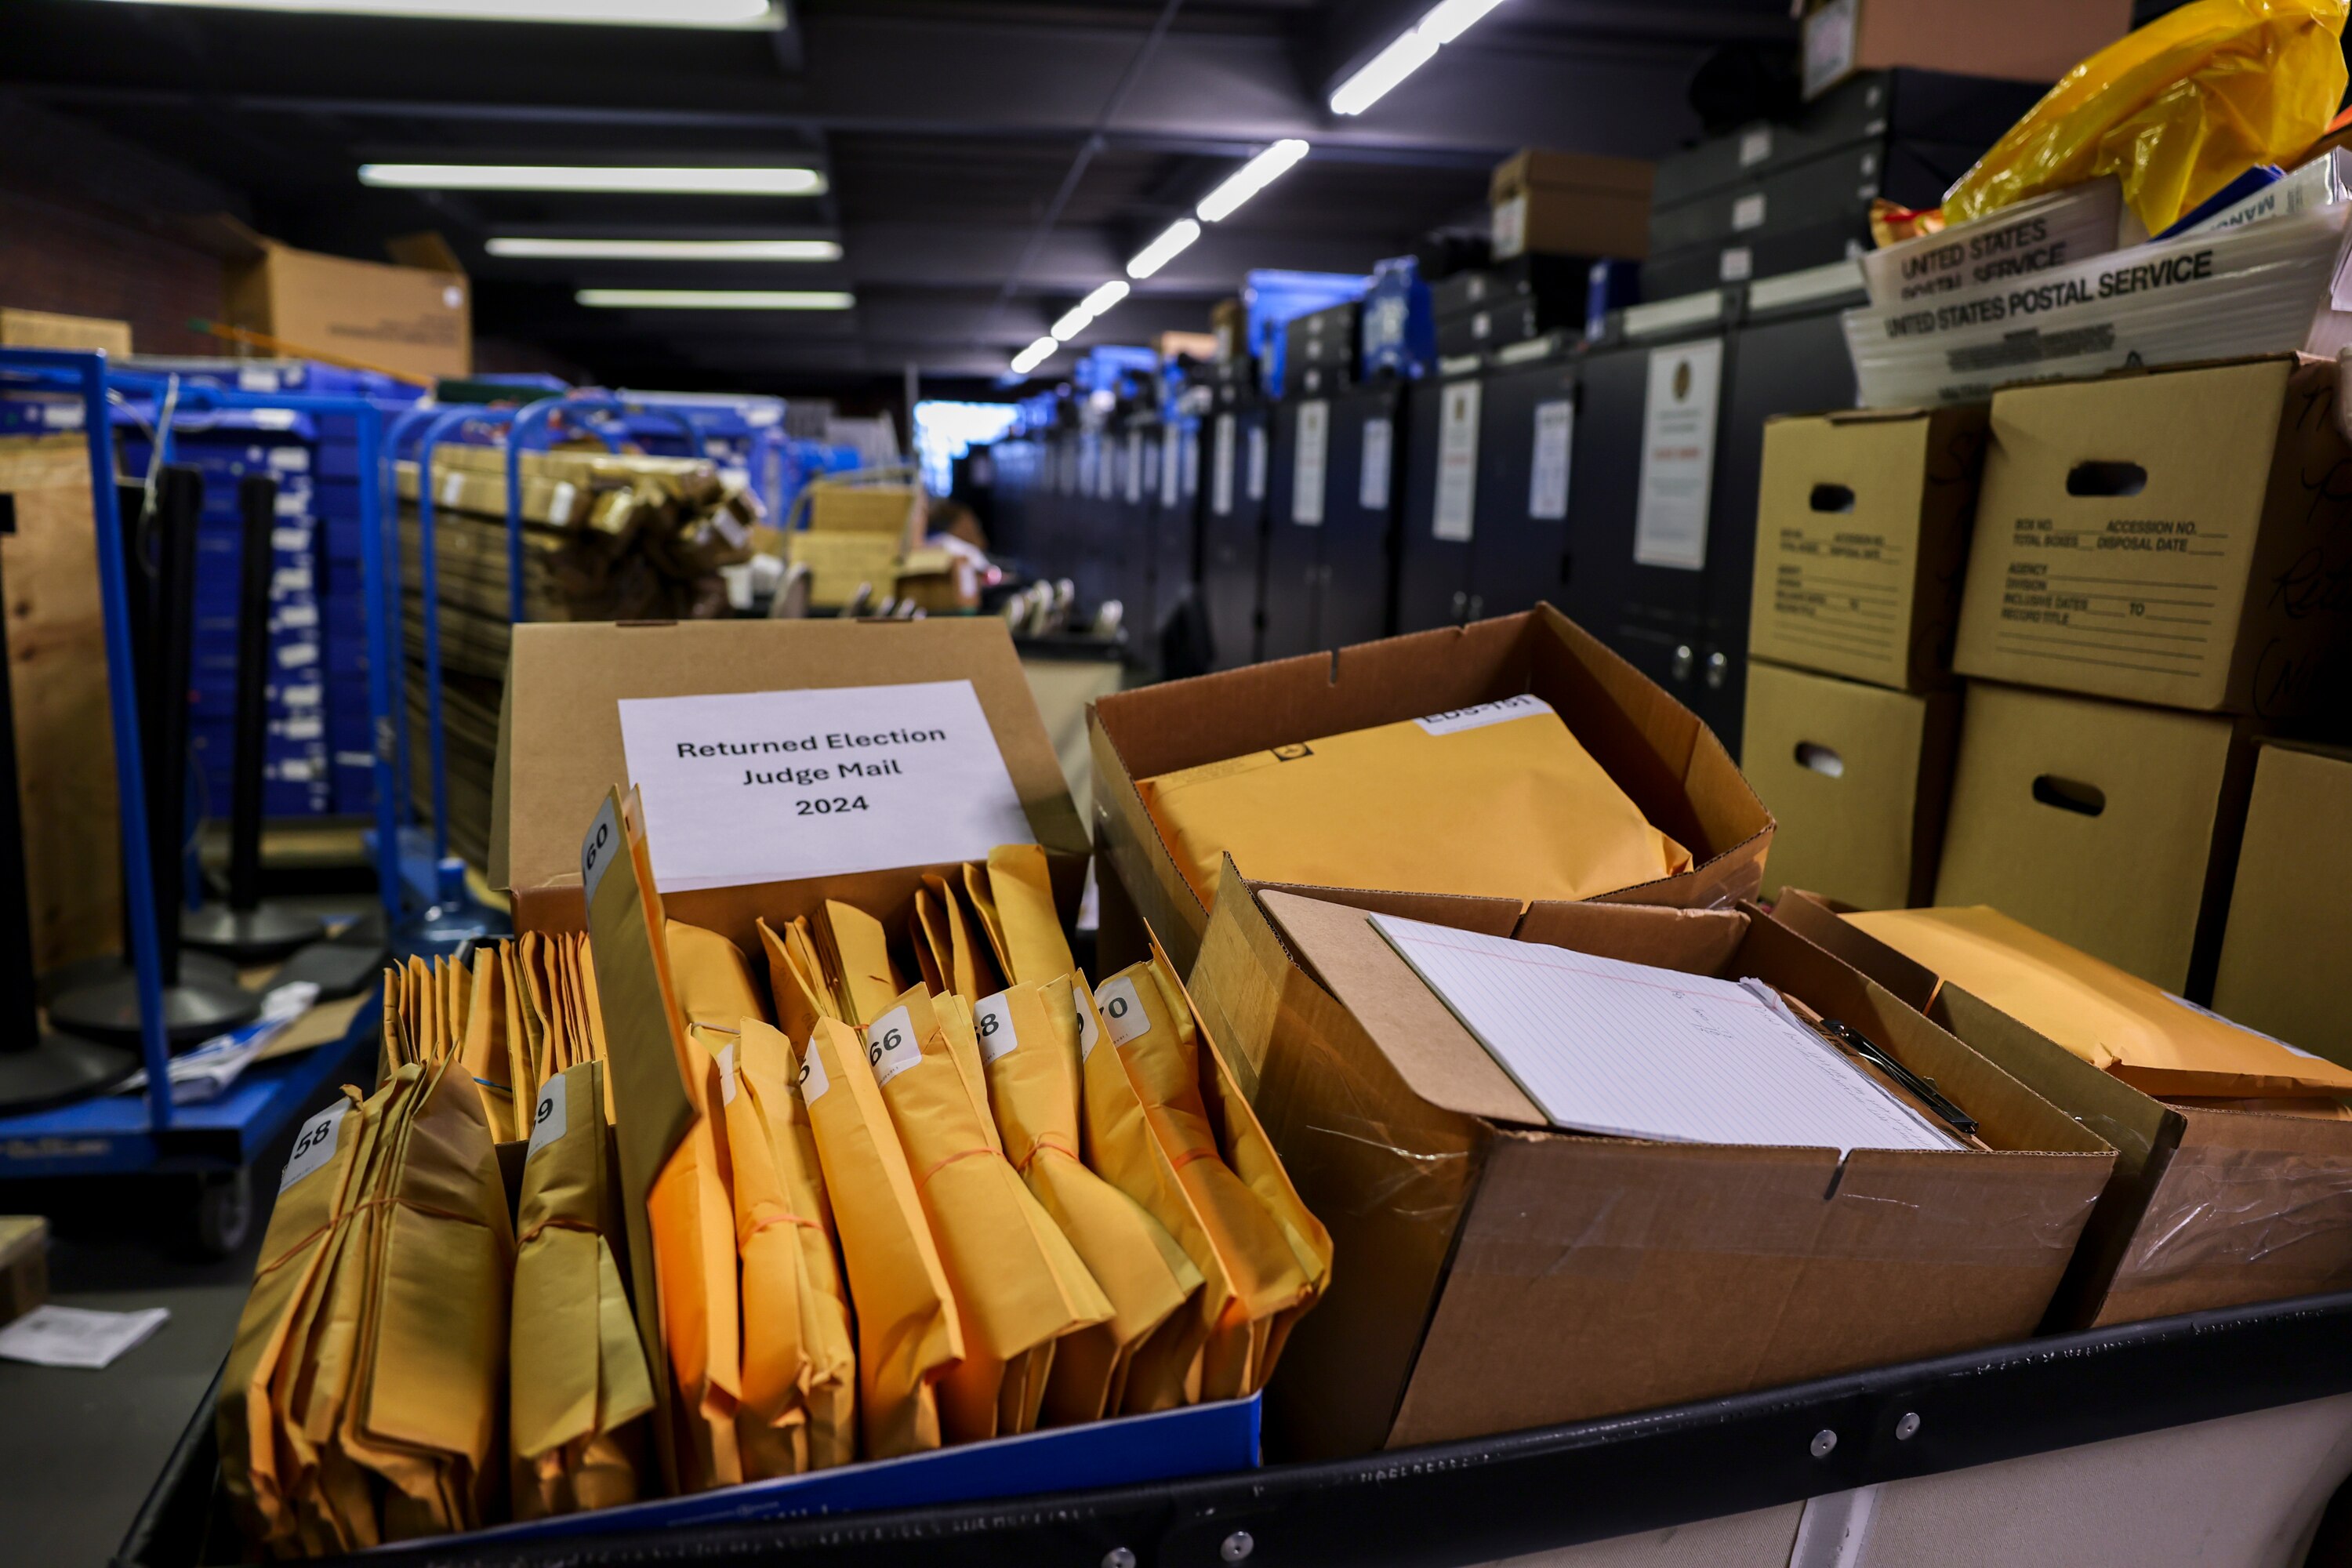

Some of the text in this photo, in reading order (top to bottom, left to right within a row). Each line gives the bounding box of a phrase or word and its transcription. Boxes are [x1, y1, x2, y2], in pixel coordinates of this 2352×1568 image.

[1901, 218, 2048, 280] UNITED STATES
[1973, 240, 2067, 283] SERVICE
[1884, 250, 2213, 338] UNITED STATES POSTAL SERVICE
[2096, 535, 2153, 550] DISPOSAL
[2156, 538, 2188, 552] DATE
[2106, 520, 2173, 535] ACCESSION
[2176, 521, 2196, 535] NO.
[2129, 602, 2145, 616] TO
[677, 728, 946, 758] Returned Election
[743, 759, 903, 786] Judge Mail
[795, 795, 869, 815] 2024
[586, 823, 608, 870] 60
[869, 1028, 902, 1067] 66
[294, 1120, 332, 1160] 58
